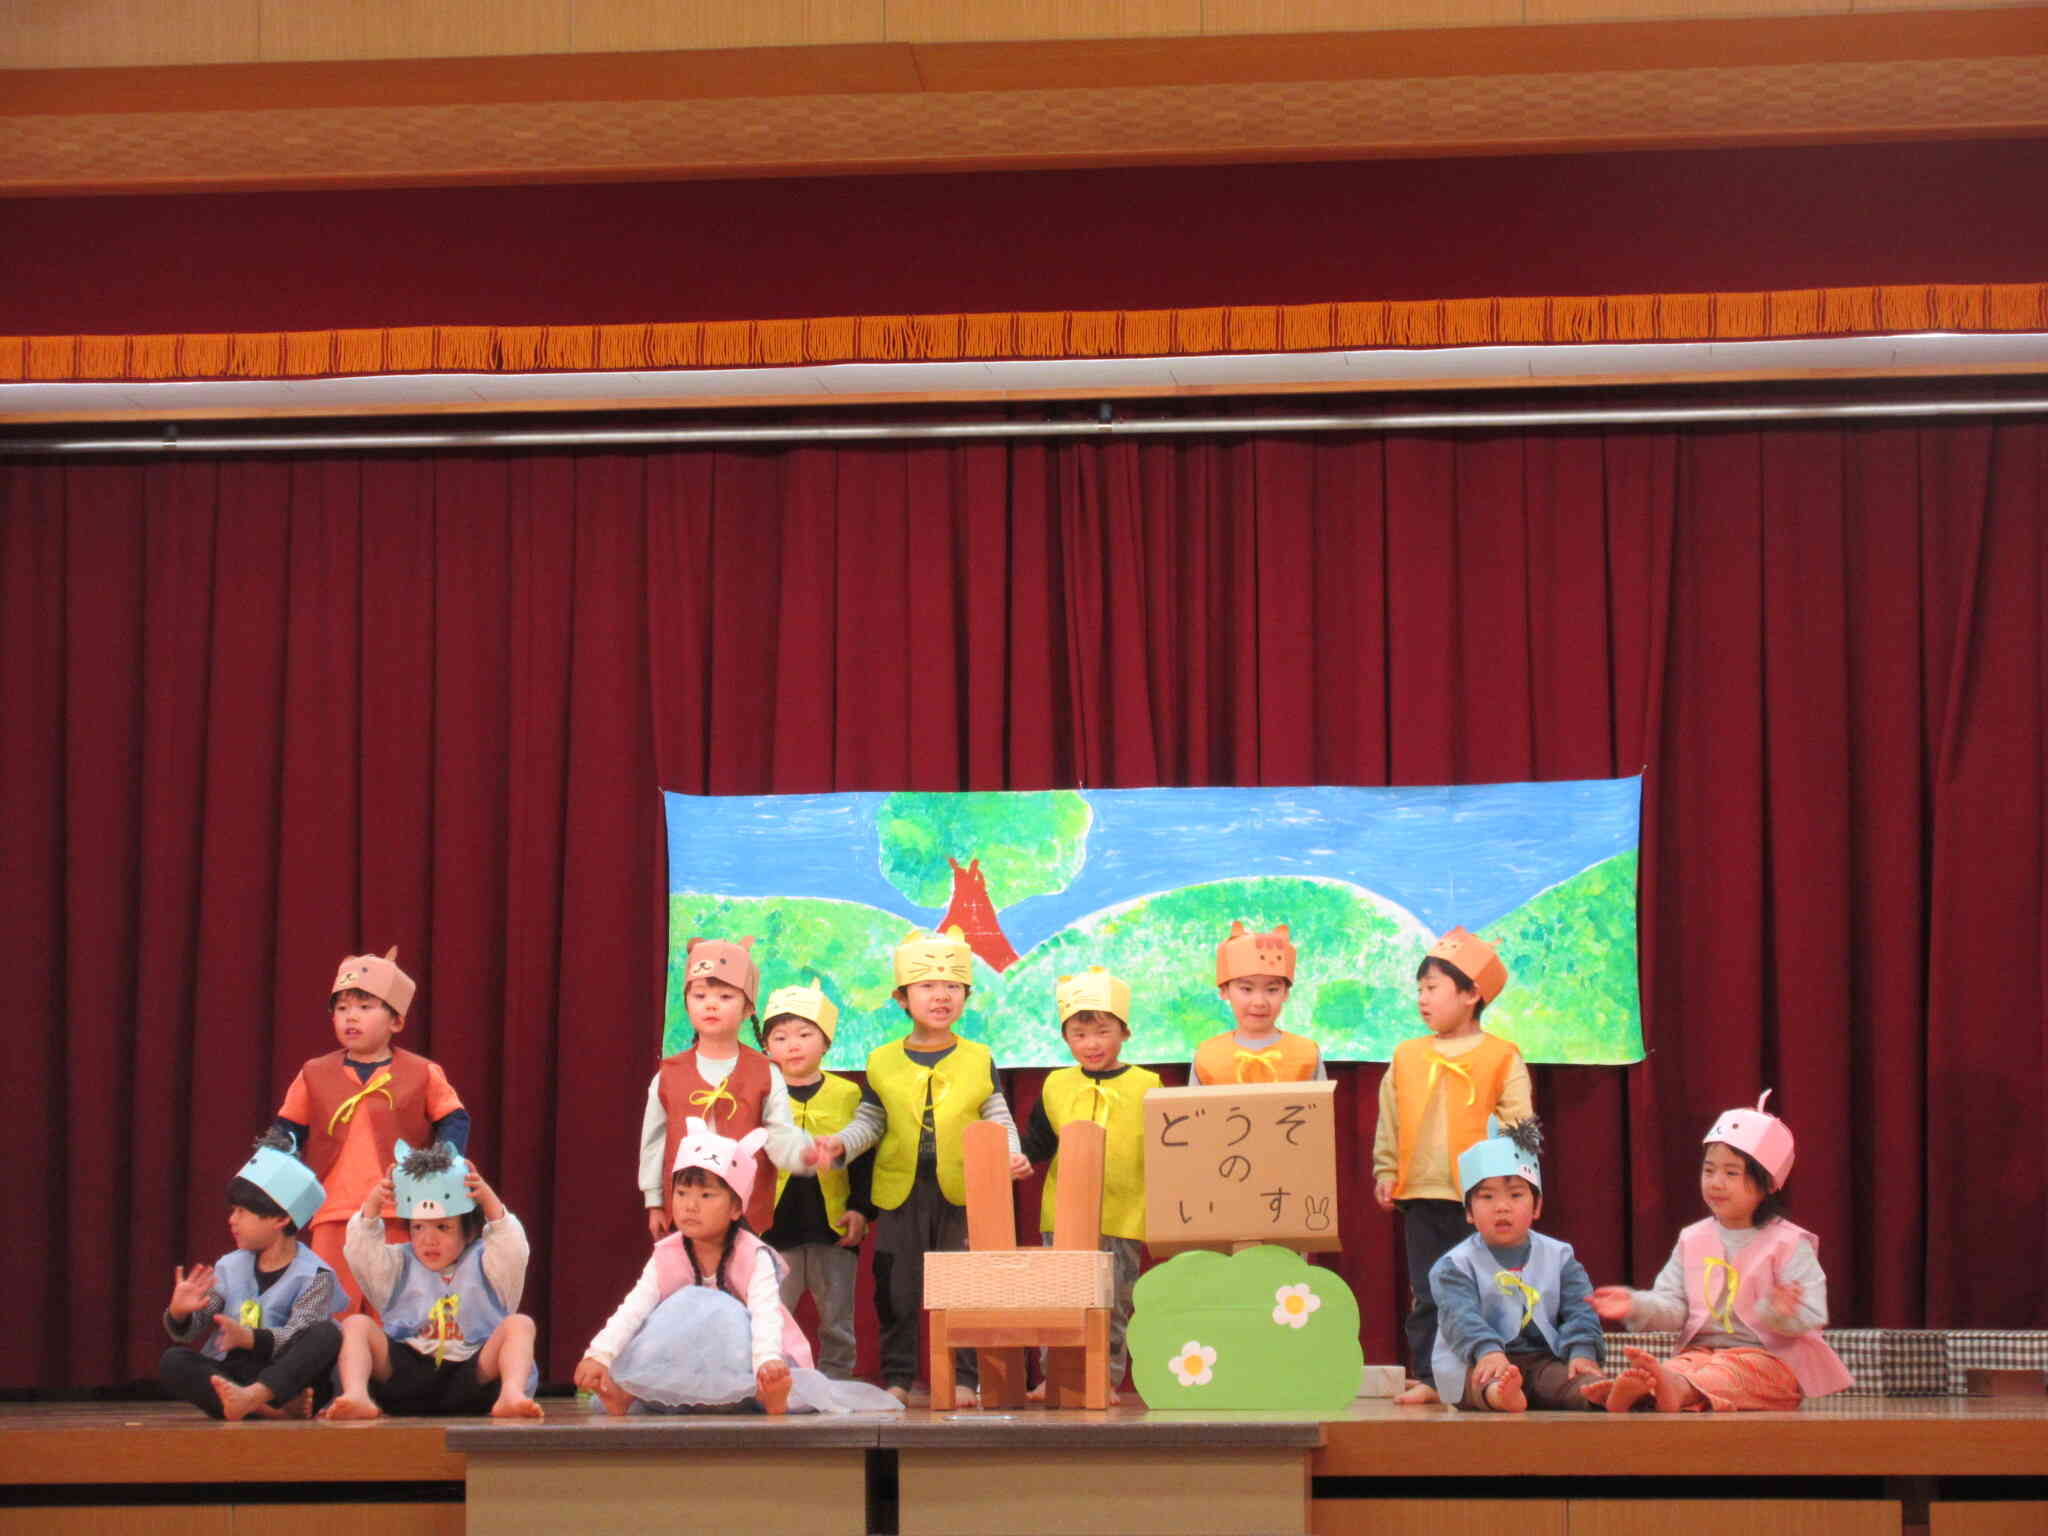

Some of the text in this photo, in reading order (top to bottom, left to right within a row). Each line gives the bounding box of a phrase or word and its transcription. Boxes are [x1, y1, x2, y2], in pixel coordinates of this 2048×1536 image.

[1161, 1104, 1316, 1146] どうぞ
[1219, 1155, 1251, 1182] の
[1179, 1187, 1291, 1223] いす
